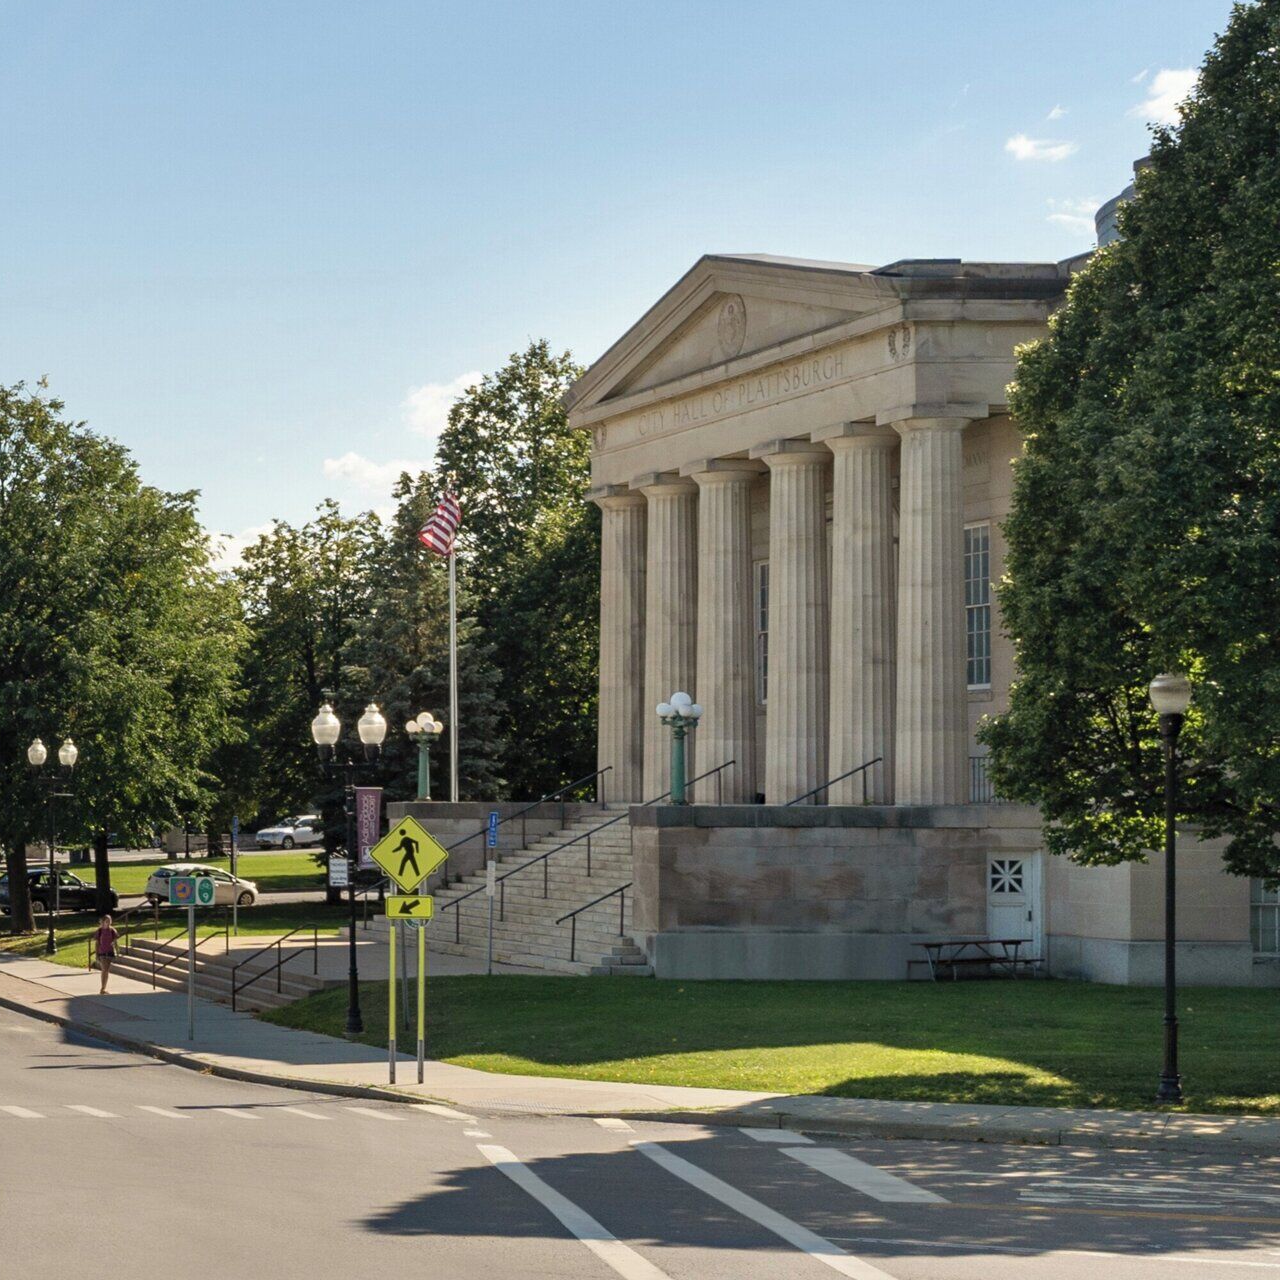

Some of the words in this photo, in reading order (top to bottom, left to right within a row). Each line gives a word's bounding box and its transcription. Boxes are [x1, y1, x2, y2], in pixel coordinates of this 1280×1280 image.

[639, 413, 665, 436] CITY
[674, 398, 707, 422] HALL
[712, 392, 731, 414] OF
[739, 355, 844, 404] PLATTSBURGH
[203, 892, 209, 902] 9
